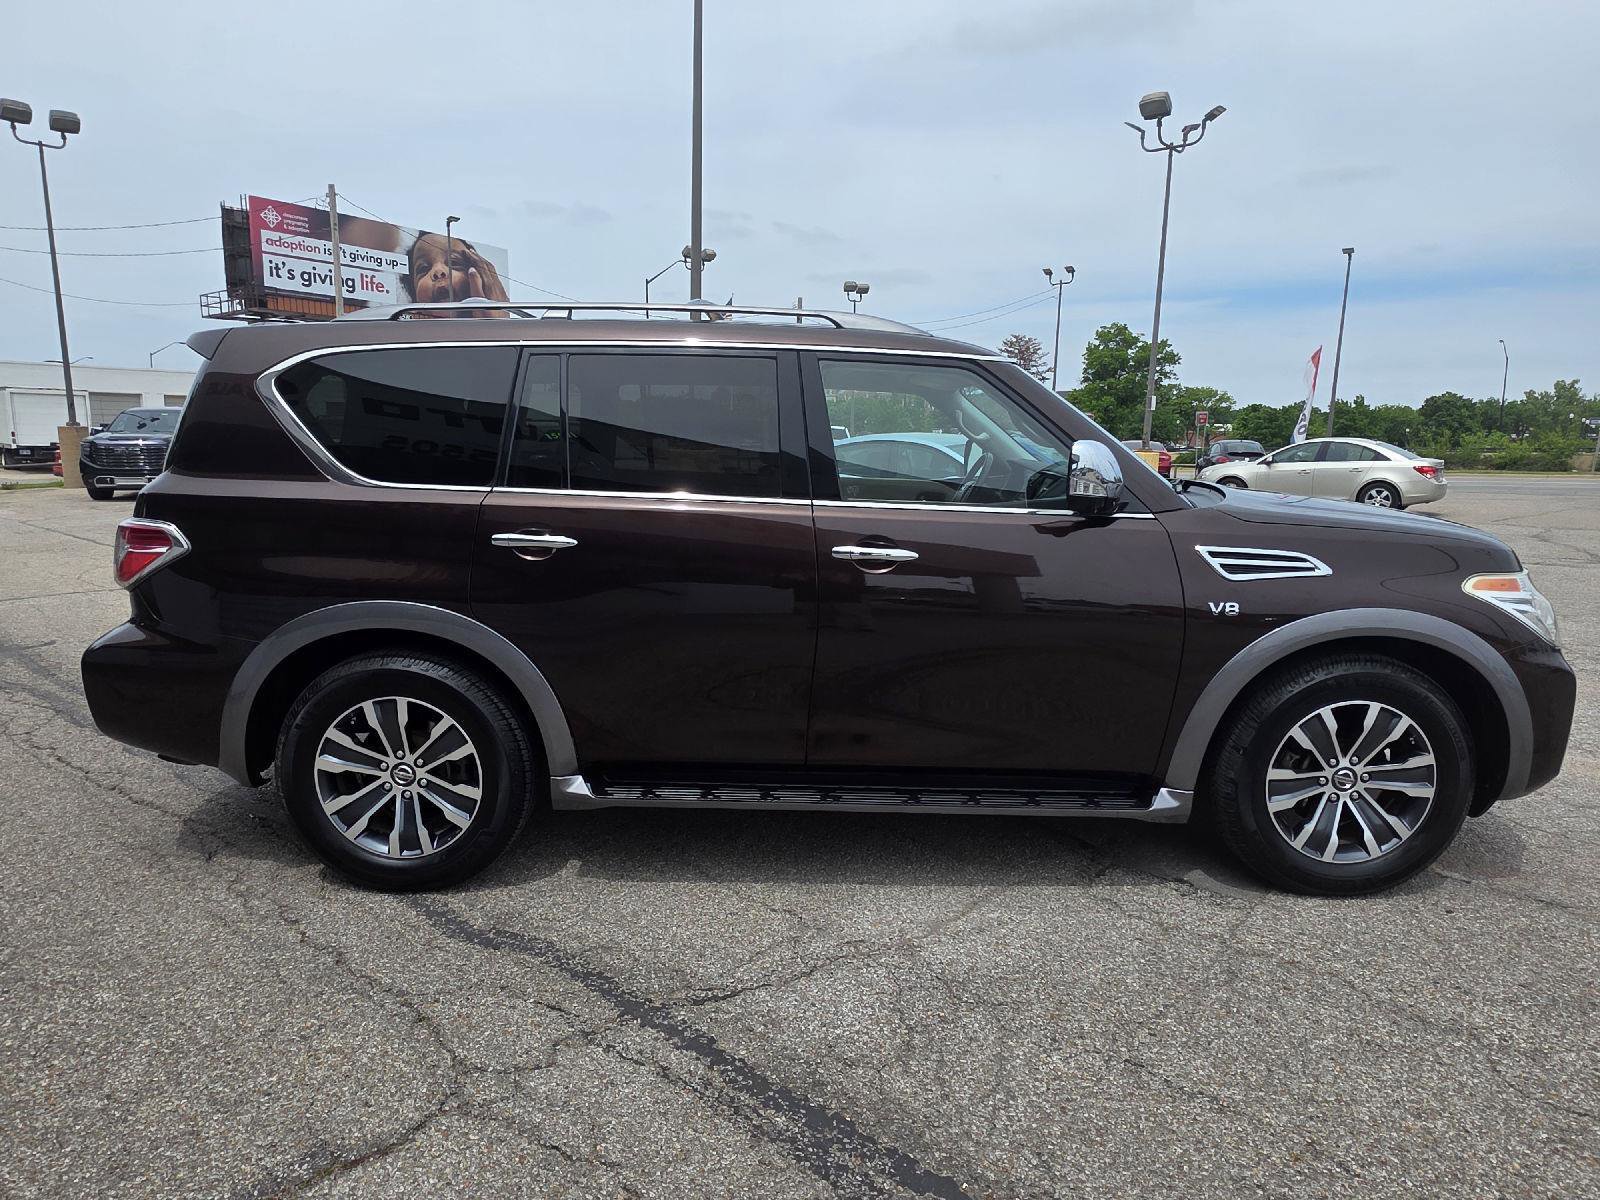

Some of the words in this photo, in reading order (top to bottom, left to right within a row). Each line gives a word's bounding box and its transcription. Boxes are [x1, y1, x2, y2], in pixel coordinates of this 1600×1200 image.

[265, 236, 321, 254] adoption
[323, 244, 347, 258] is't
[349, 250, 383, 267] giving
[268, 260, 296, 281] it's
[360, 272, 390, 295] life.
[1208, 602, 1240, 617] V8
